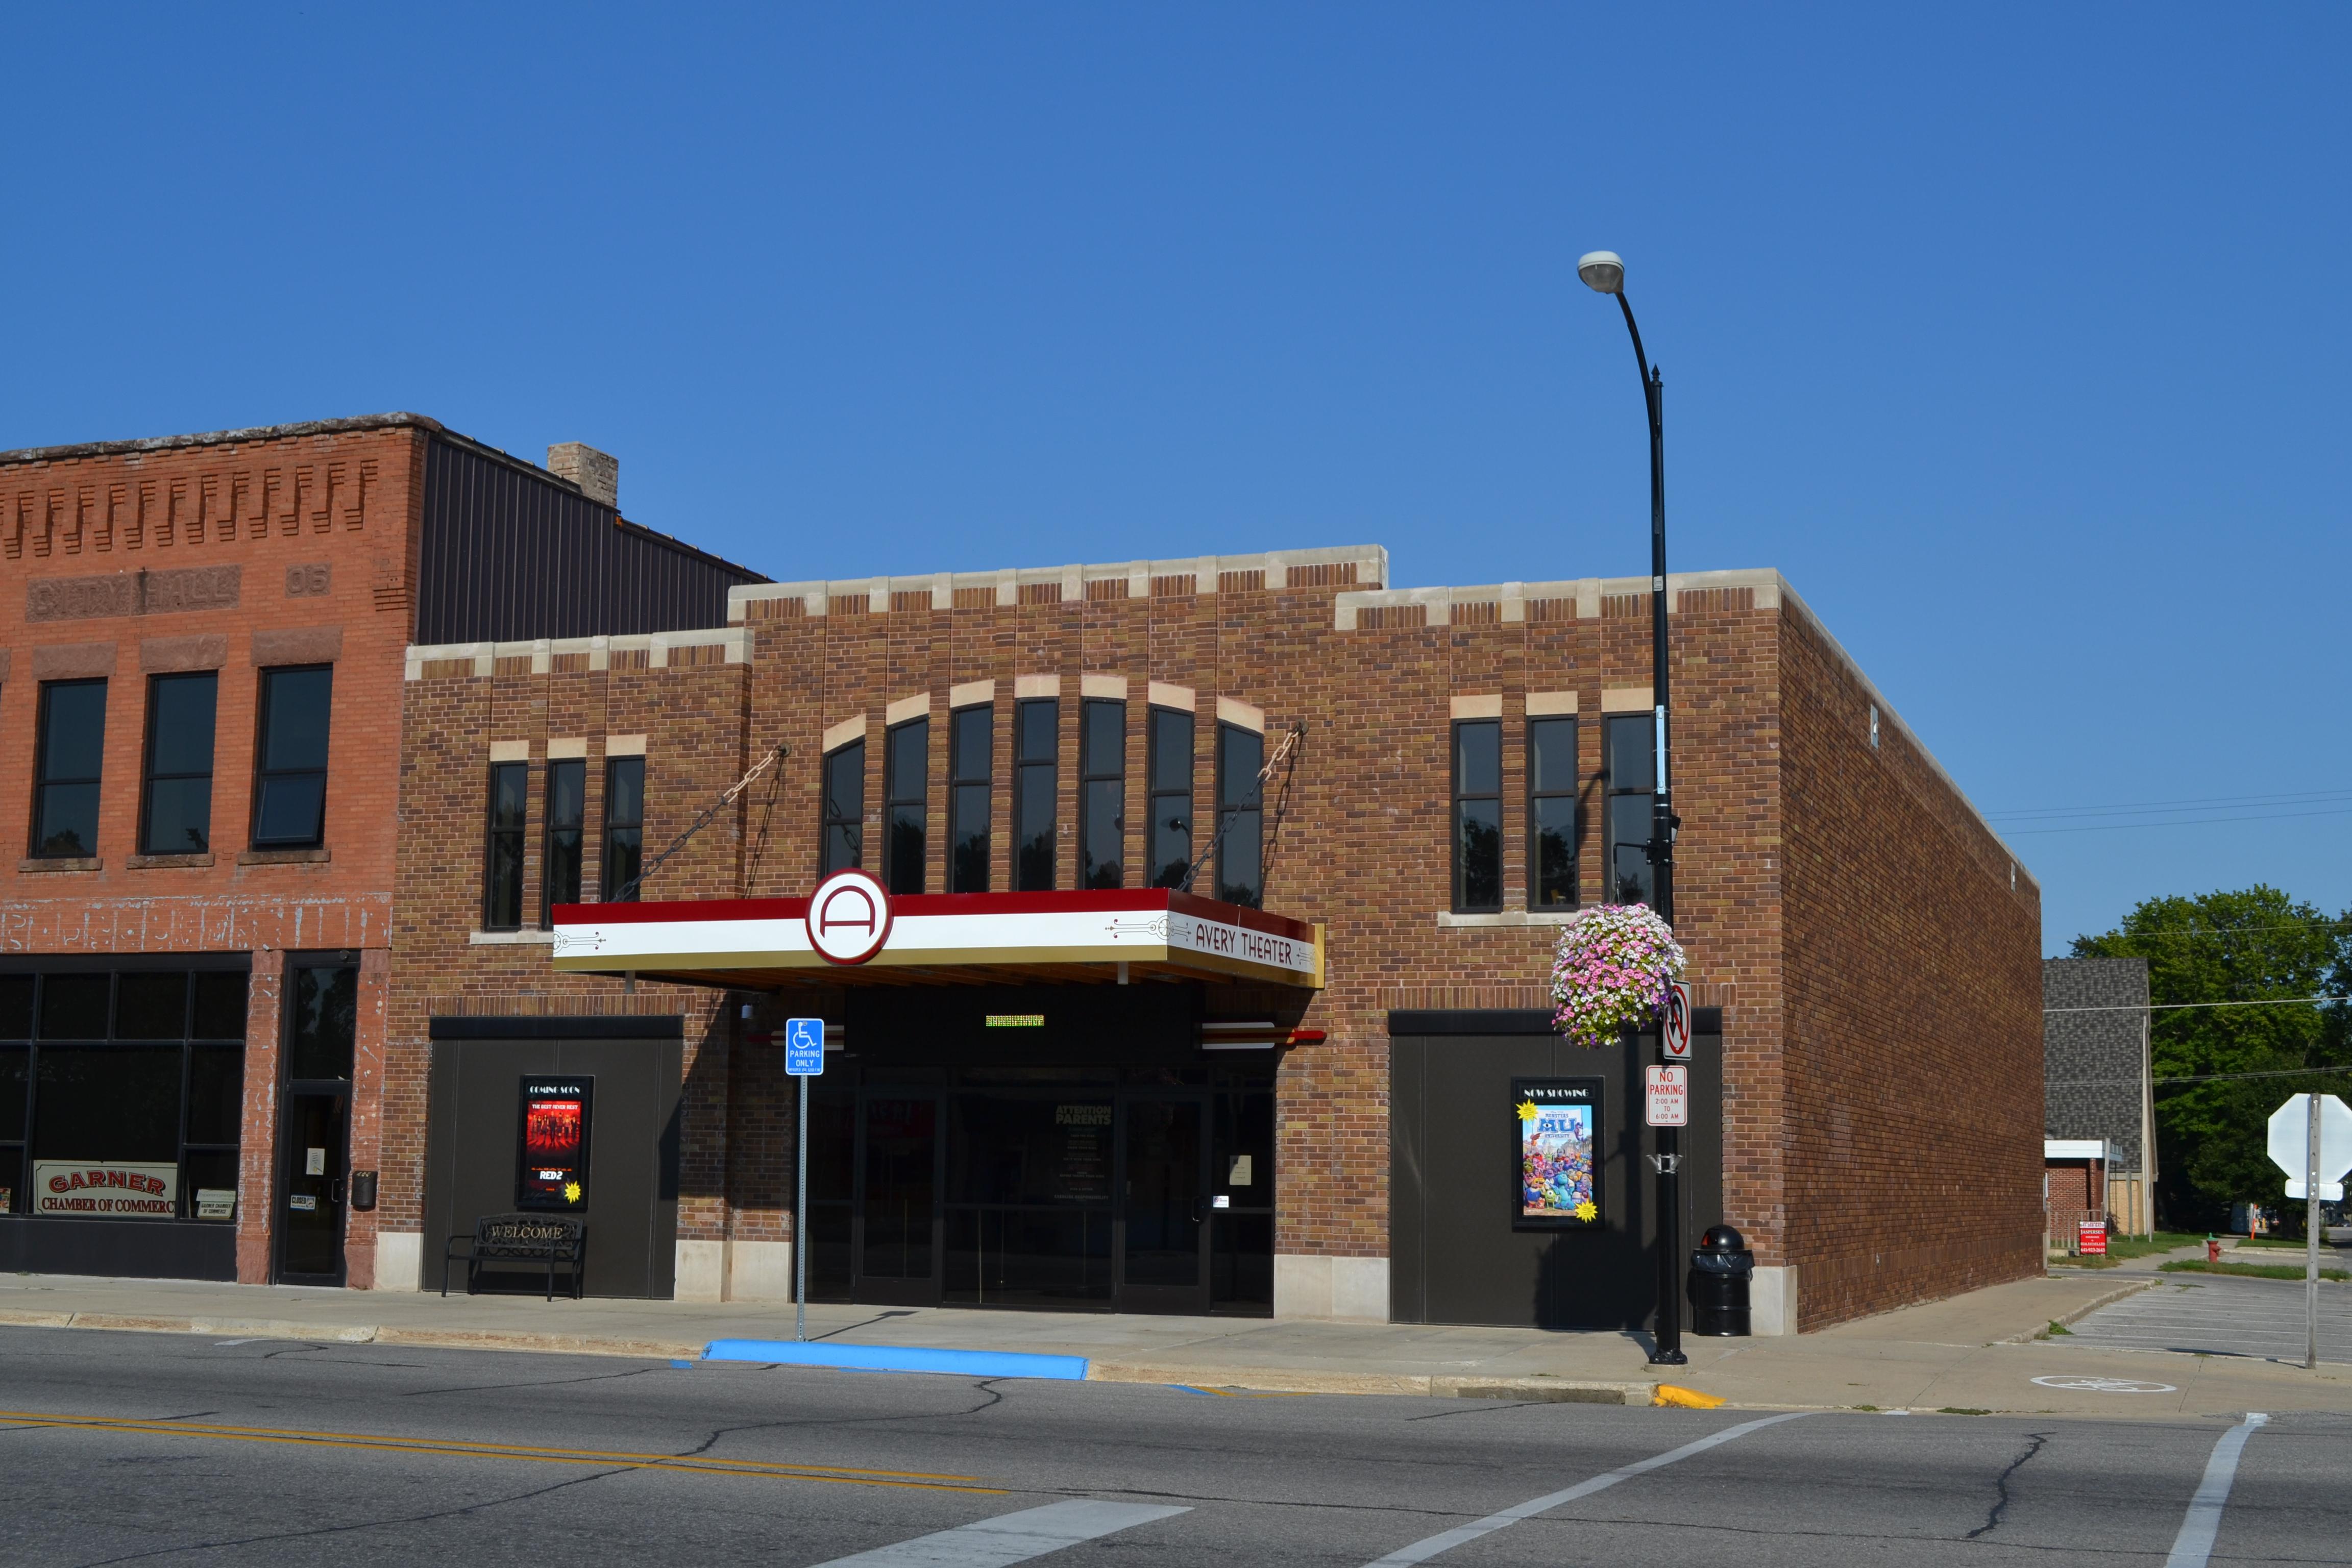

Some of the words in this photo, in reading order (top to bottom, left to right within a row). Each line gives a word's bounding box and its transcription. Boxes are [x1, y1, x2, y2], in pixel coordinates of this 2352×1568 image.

[35, 578, 127, 614] CITY
[141, 572, 234, 609] HALL
[820, 885, 875, 938] A
[1196, 923, 1236, 953] AVERY
[1241, 933, 1292, 965] THEATER
[1659, 1071, 1673, 1082] NO
[1547, 1089, 1589, 1097] SHOWING
[1650, 1084, 1683, 1095] PARKING
[1056, 1105, 1112, 1114] ATTENTION
[1056, 1114, 1112, 1125] PARENTS
[1537, 1117, 1577, 1133] MU
[49, 1170, 166, 1197] GARNER
[42, 1197, 96, 1211] CHAMBER
[98, 1199, 113, 1212] OF
[115, 1199, 176, 1213] COMMERC
[292, 1196, 306, 1204] CLOSED
[492, 1226, 562, 1239] WELCOME
